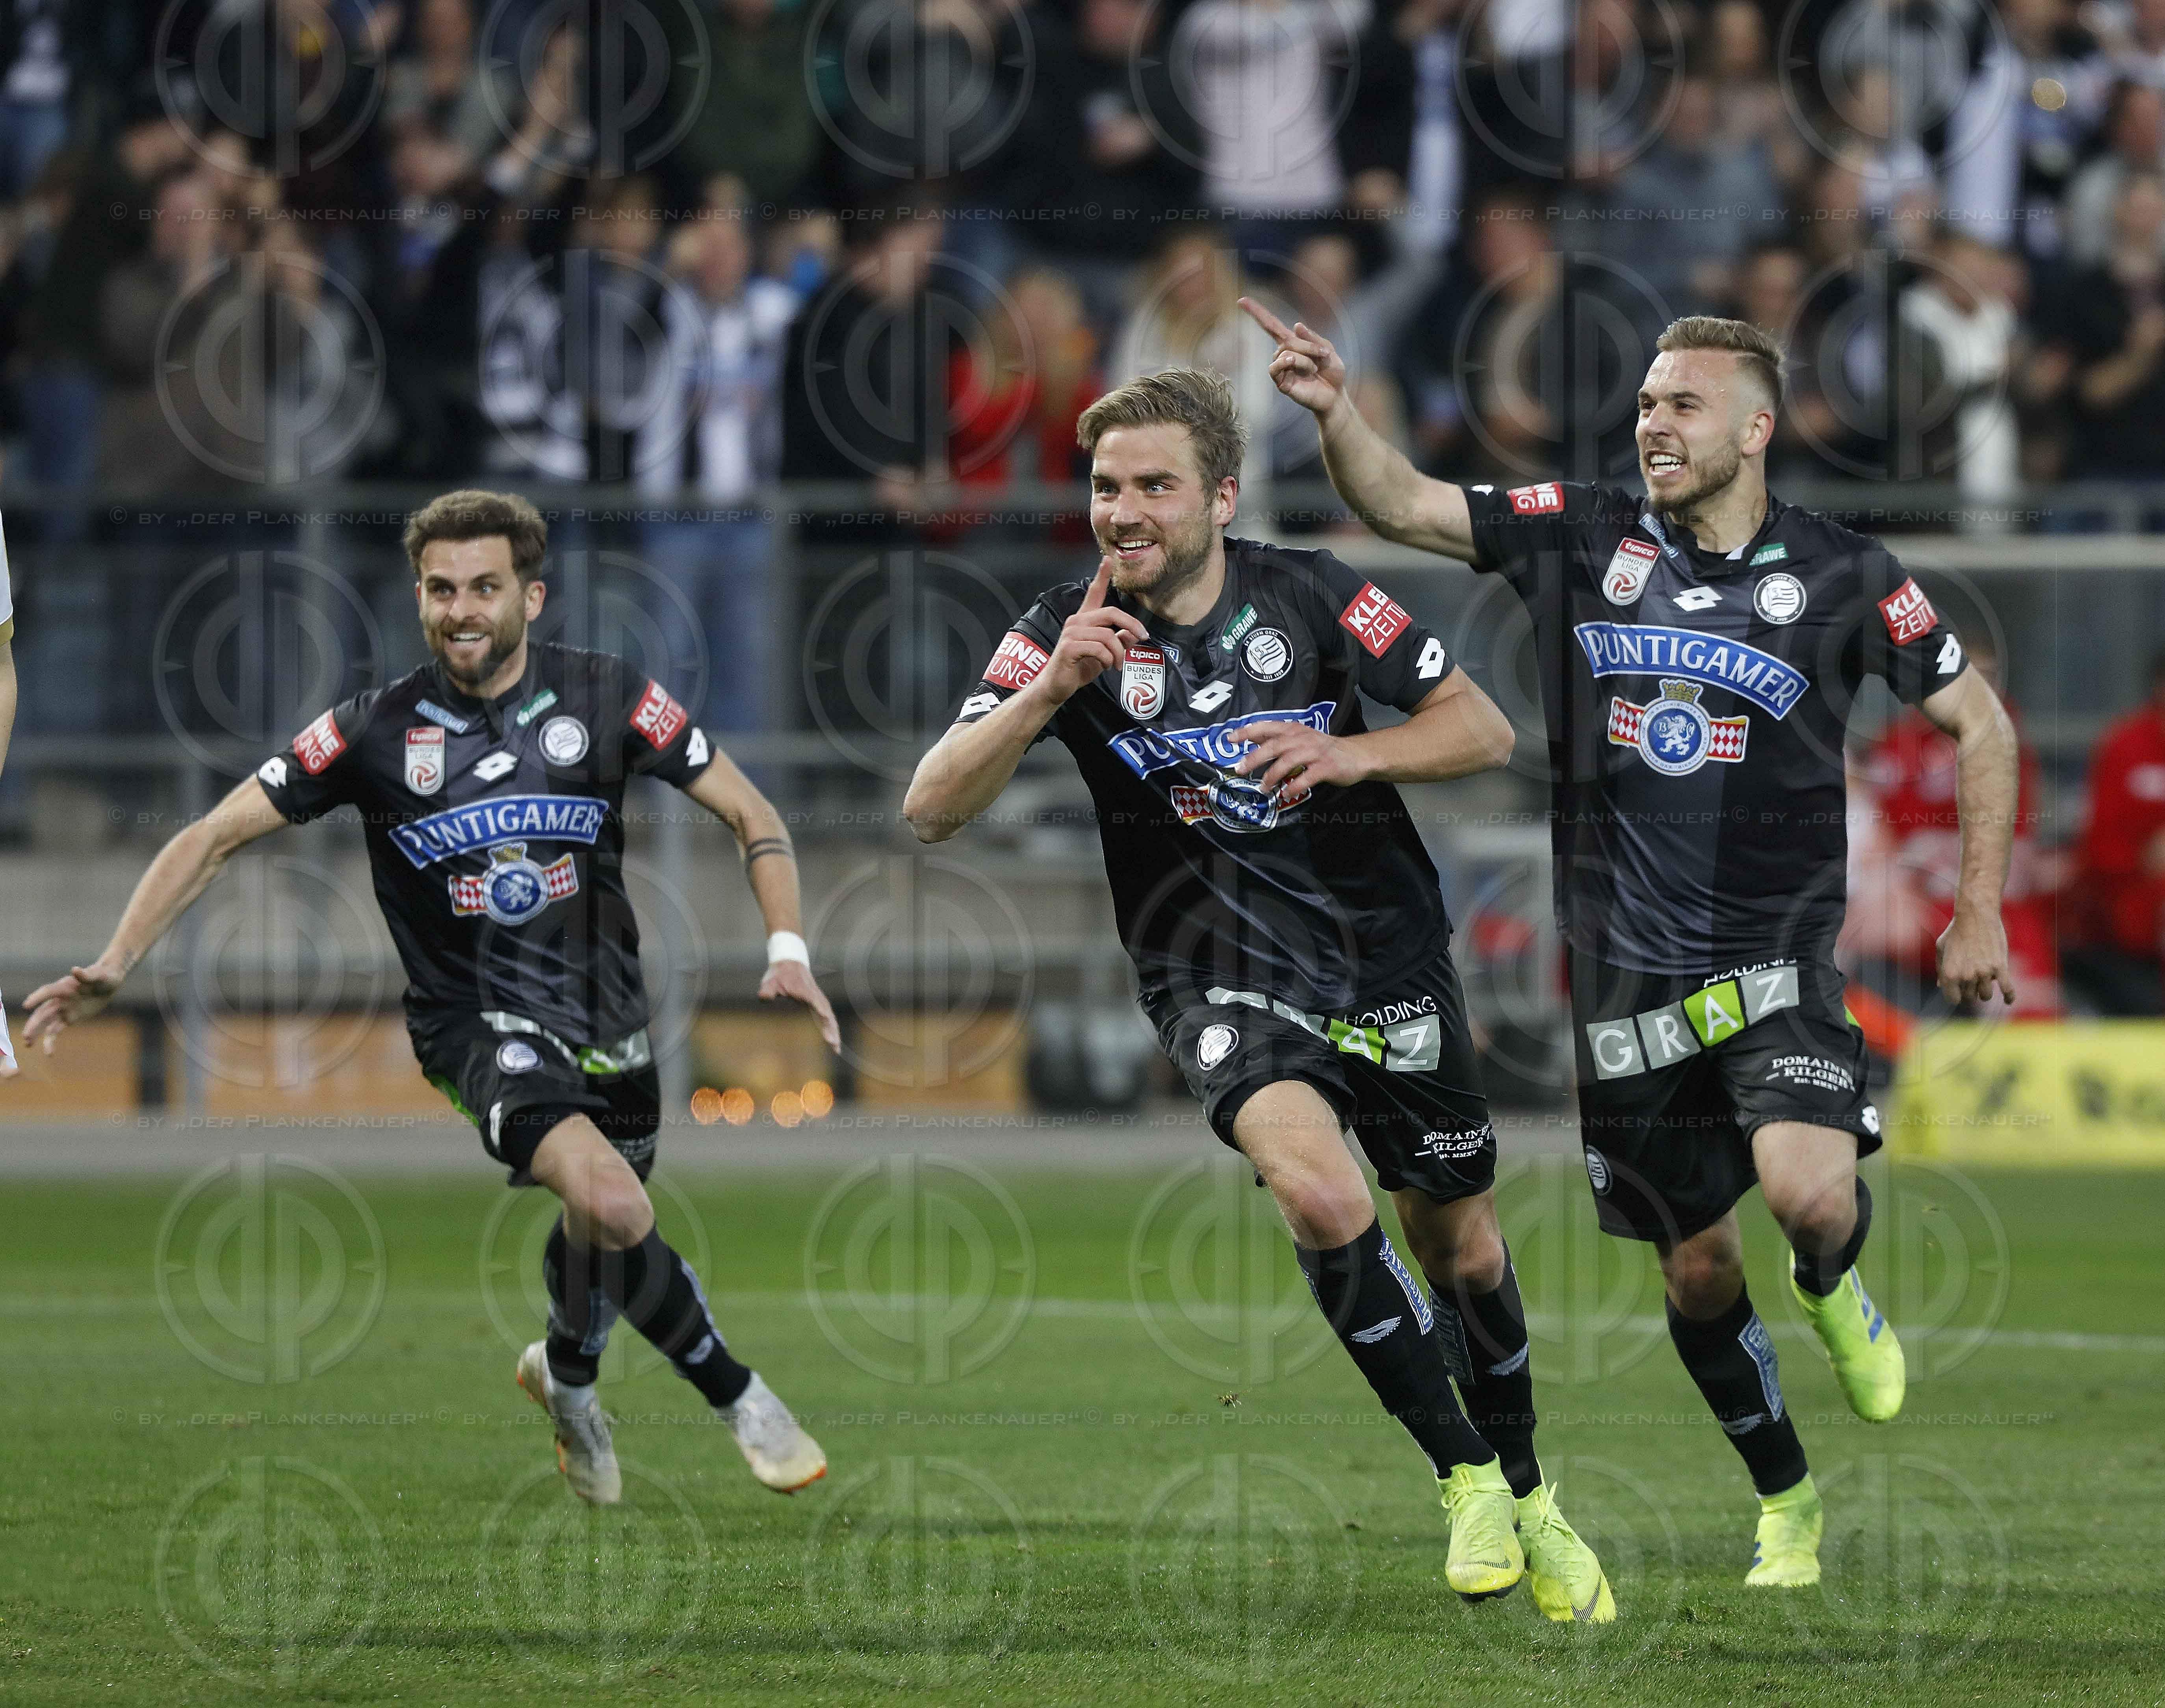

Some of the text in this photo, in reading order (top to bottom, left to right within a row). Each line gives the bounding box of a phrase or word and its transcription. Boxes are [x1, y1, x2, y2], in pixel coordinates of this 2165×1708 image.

[1625, 541, 1655, 556] tipico
[1617, 553, 1650, 569] BUNDES
[1621, 562, 1639, 572] LIGA
[1129, 648, 1160, 660] tipico
[1127, 665, 1162, 674] BUNDES
[1584, 630, 1798, 708] PUNTIGAMER
[1344, 996, 1437, 1026] HOLDING
[1595, 972, 1786, 1072] GRAZ
